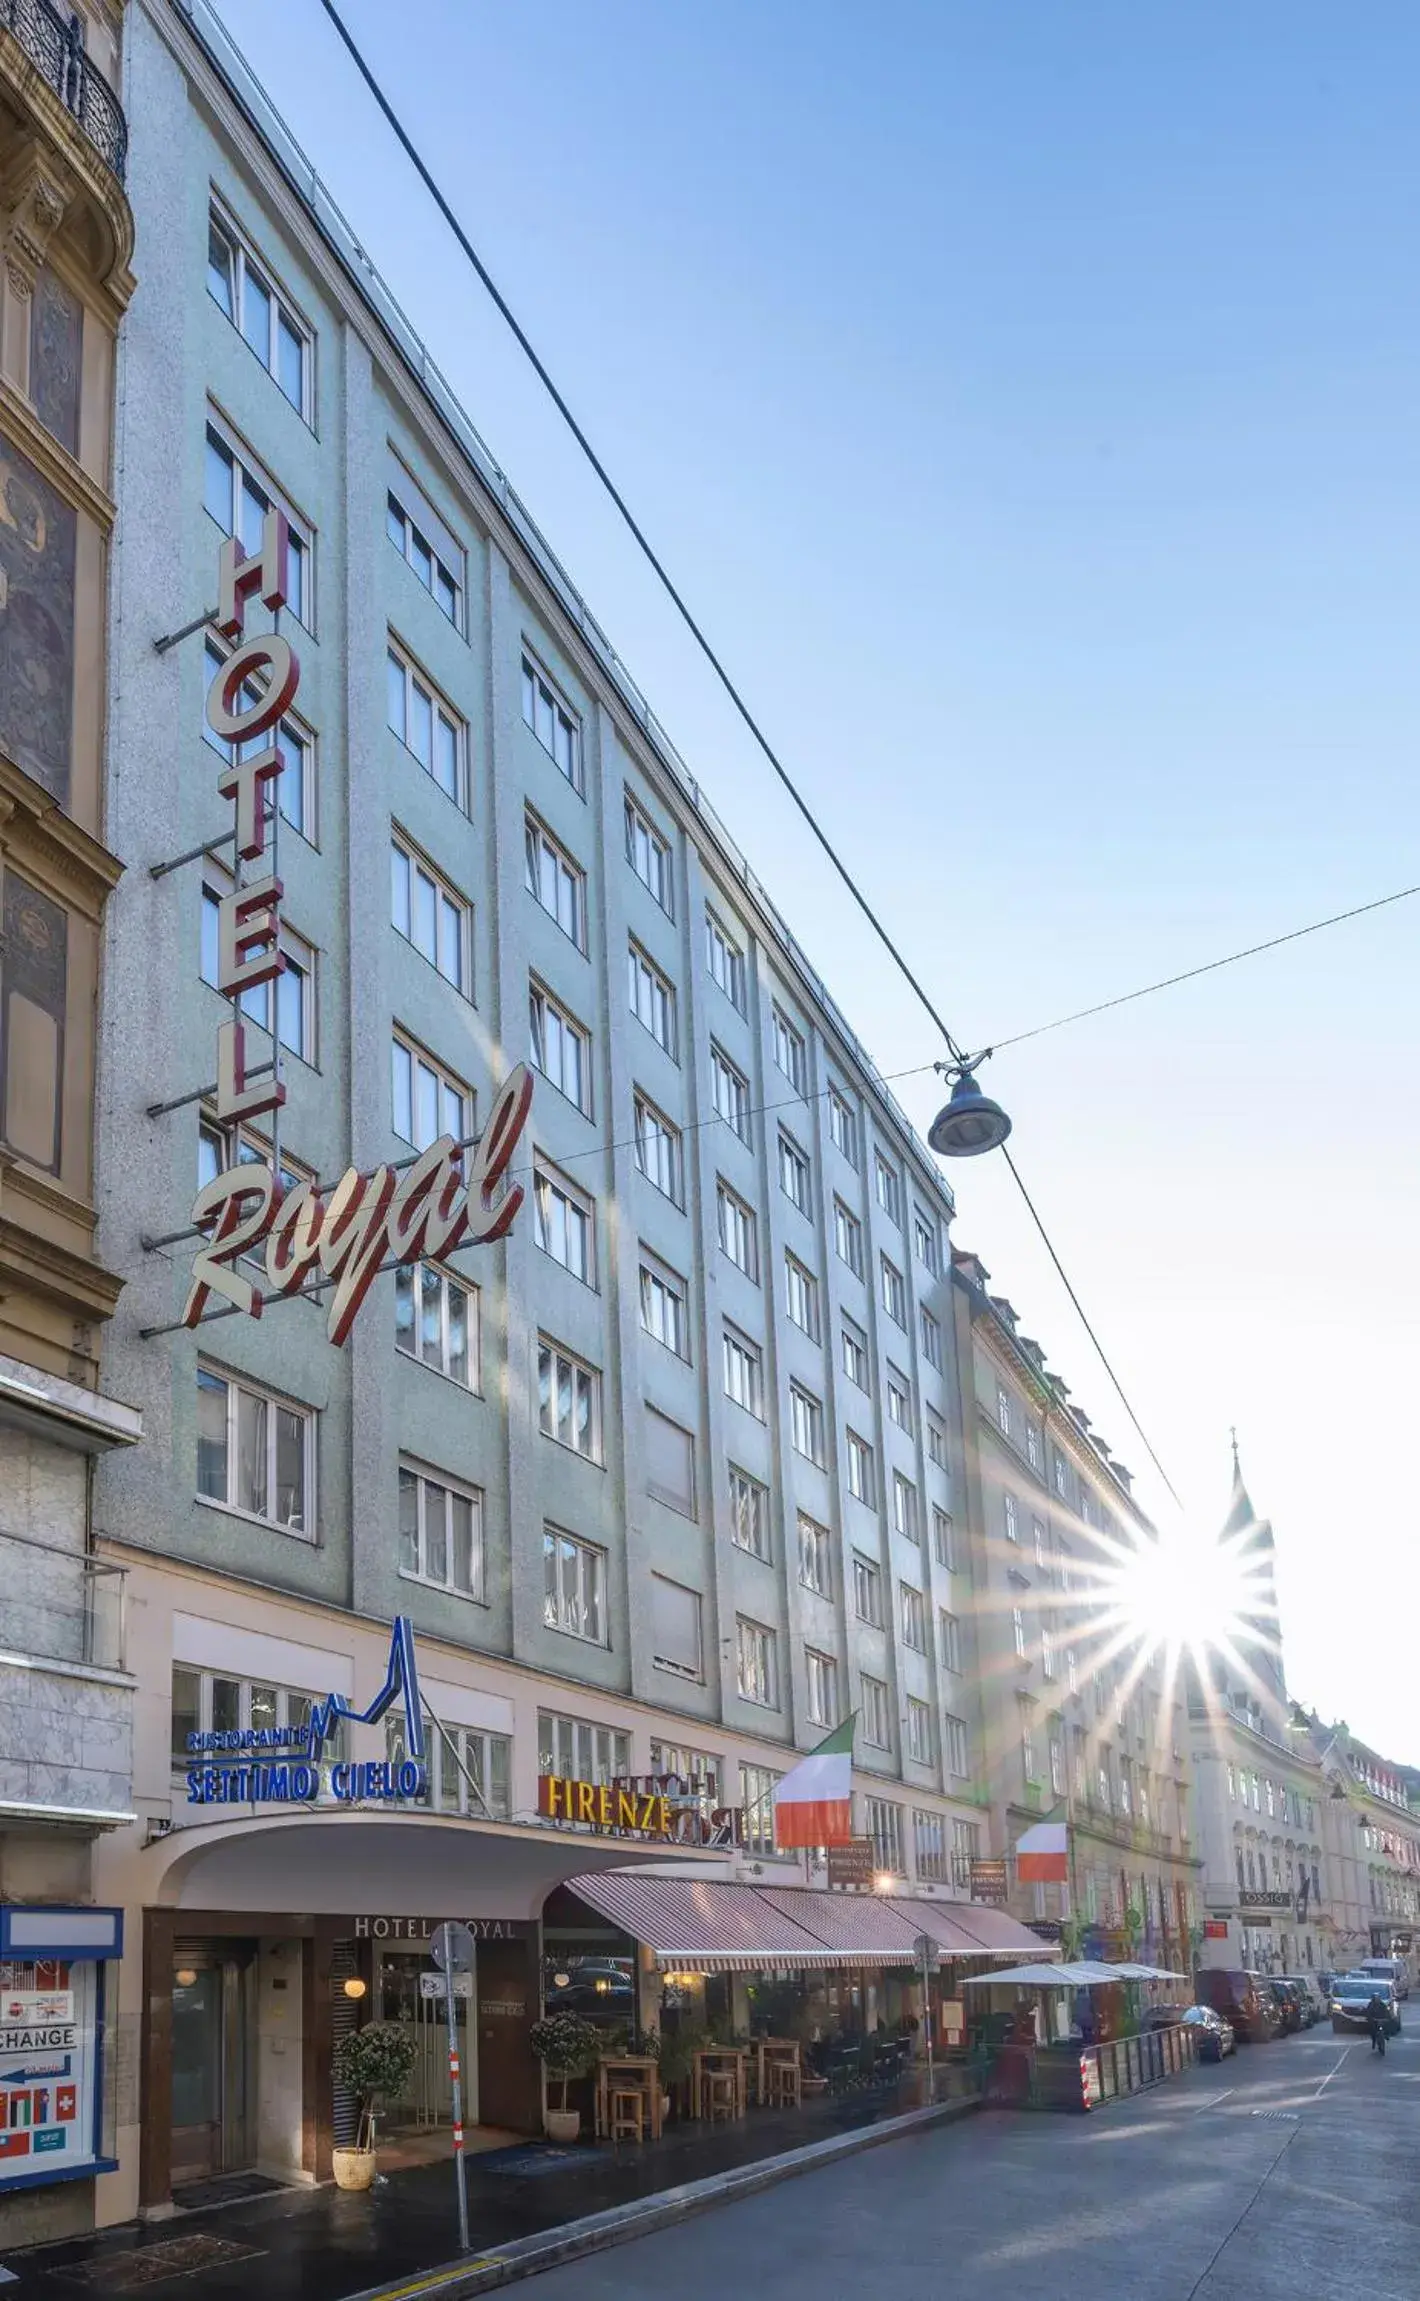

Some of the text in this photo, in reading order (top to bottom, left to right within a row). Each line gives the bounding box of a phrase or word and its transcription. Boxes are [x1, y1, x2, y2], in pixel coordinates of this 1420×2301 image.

[206, 507, 300, 1124] HOTEL
[183, 1061, 534, 1348] Royal
[186, 1727, 311, 1751] RISTORANTE
[187, 1760, 427, 1803] SETTIMO CIELO
[547, 1775, 673, 1834] FIRENZE
[355, 1917, 516, 1939] HOTEL OYAL
